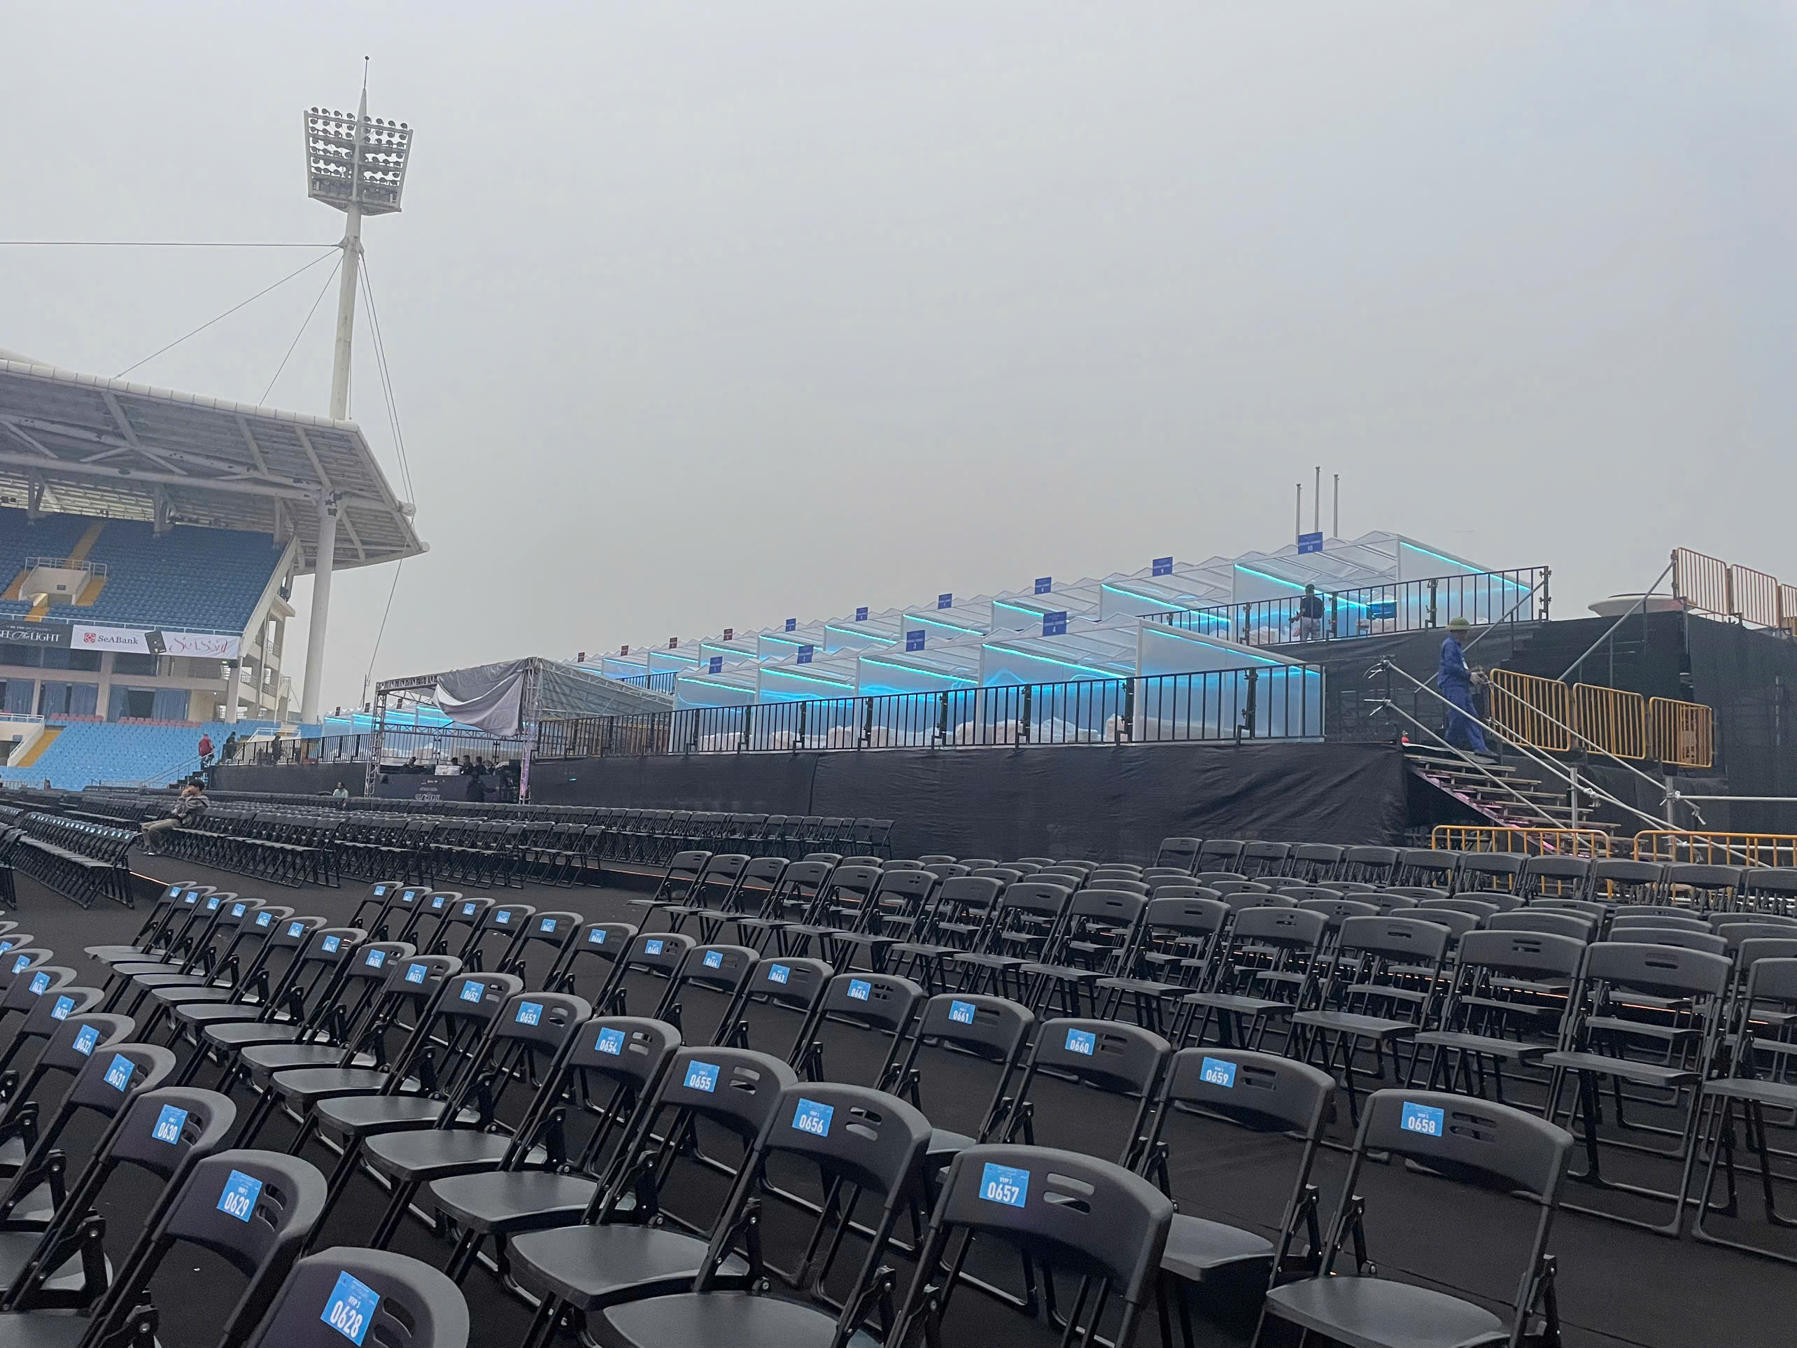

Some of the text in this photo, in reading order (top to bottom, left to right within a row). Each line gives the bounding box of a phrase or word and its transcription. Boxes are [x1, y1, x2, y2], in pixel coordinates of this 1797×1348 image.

[30, 632, 59, 642] LIGHT
[97, 634, 139, 645] SeABank
[519, 1012, 537, 1025] 0653
[952, 1010, 970, 1023] 0661
[599, 1039, 617, 1054] 0654
[1068, 1039, 1089, 1054] 0660
[107, 1069, 126, 1088] 0631
[689, 1073, 712, 1090] 0655
[1205, 1068, 1229, 1084] 0659
[157, 1121, 179, 1141] 0630
[799, 1114, 824, 1133] 0656
[1407, 1116, 1435, 1133] 0658
[987, 1181, 1019, 1204] 0657
[223, 1191, 250, 1217] 0629
[329, 1299, 363, 1338] 0628
